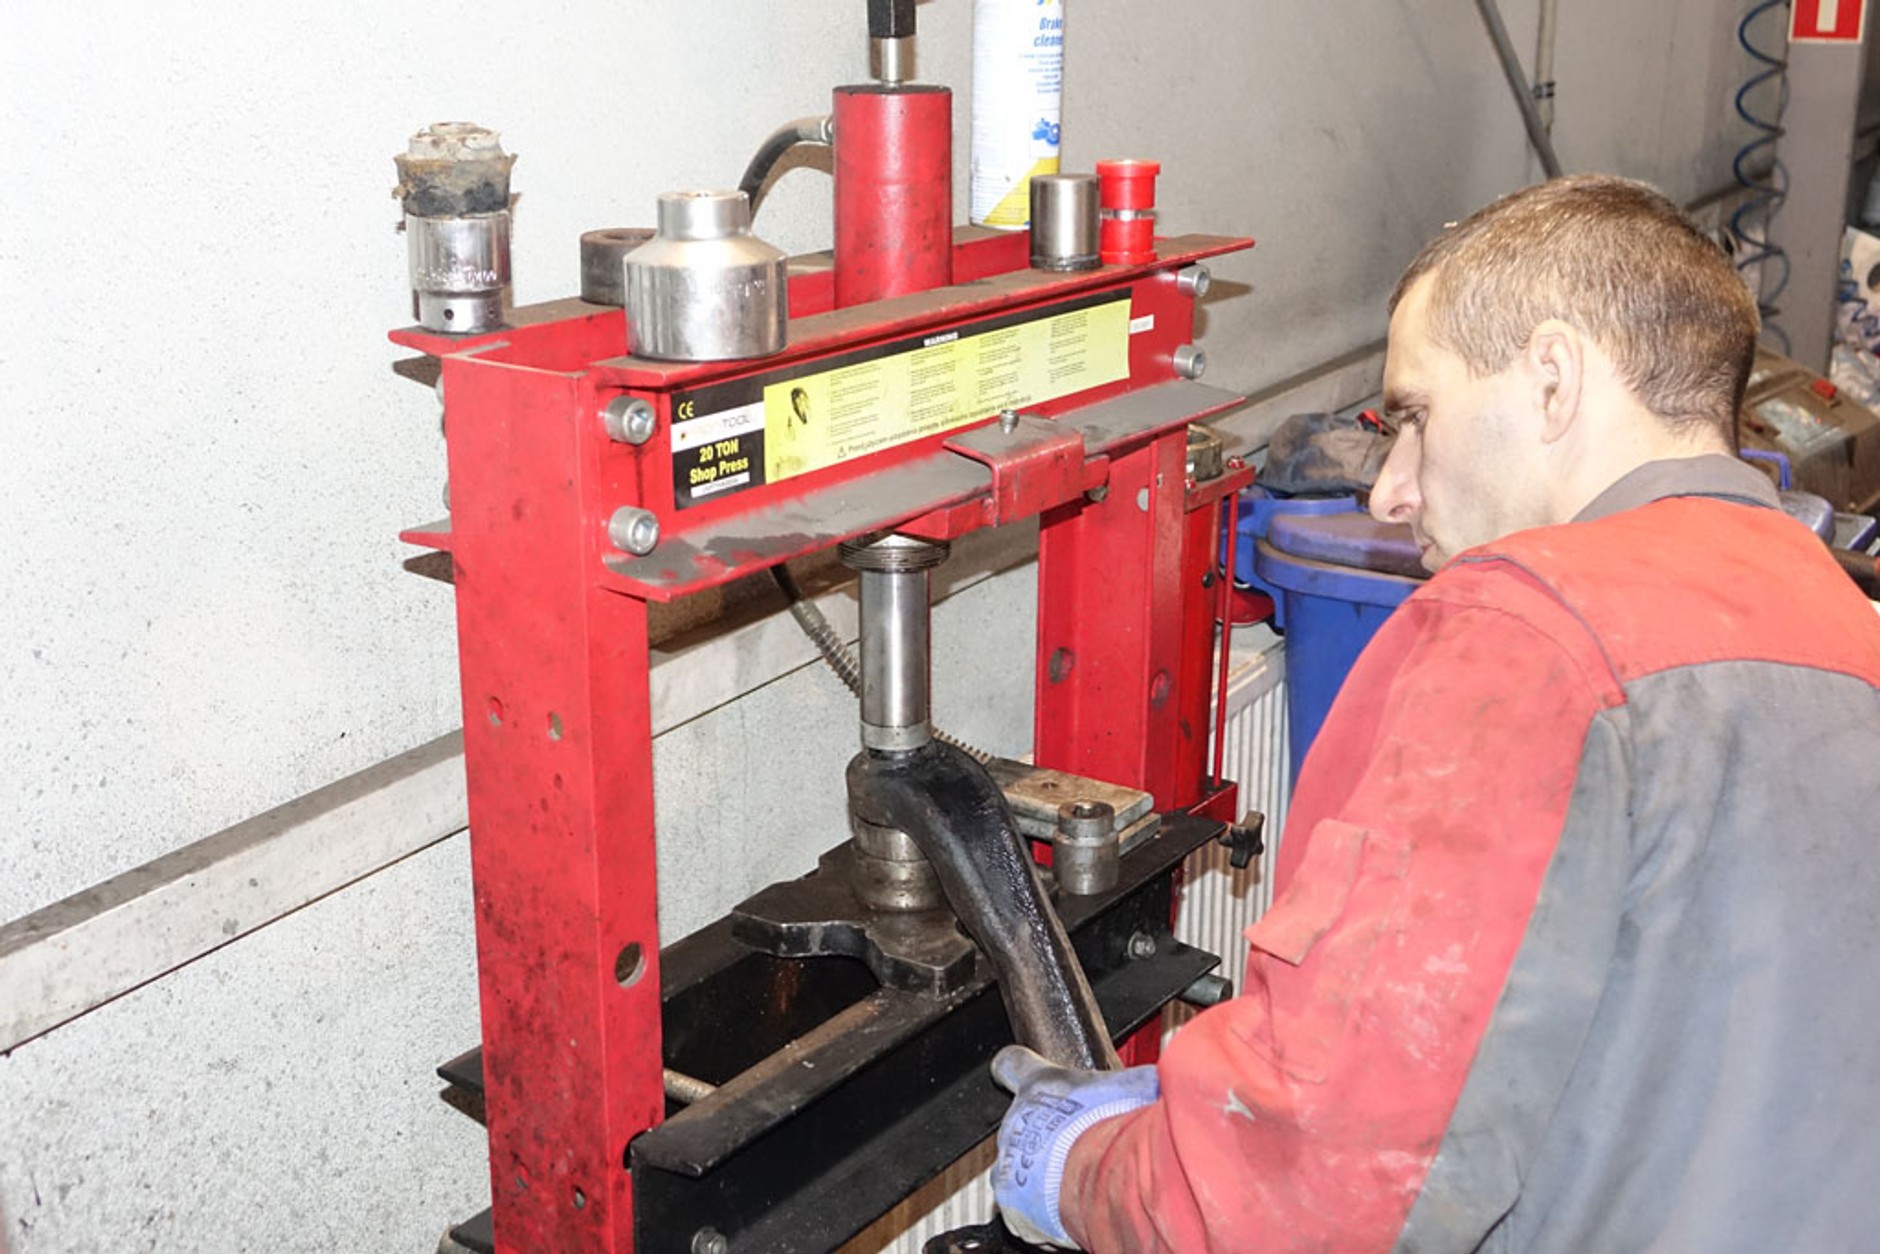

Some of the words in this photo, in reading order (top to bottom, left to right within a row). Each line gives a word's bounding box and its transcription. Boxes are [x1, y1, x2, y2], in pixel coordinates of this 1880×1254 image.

[1039, 16, 1063, 30] Brak
[1033, 34, 1063, 47] clean
[700, 445, 713, 463] 20
[715, 438, 739, 458] TON
[690, 467, 717, 484] Shop
[719, 457, 748, 475] Press
